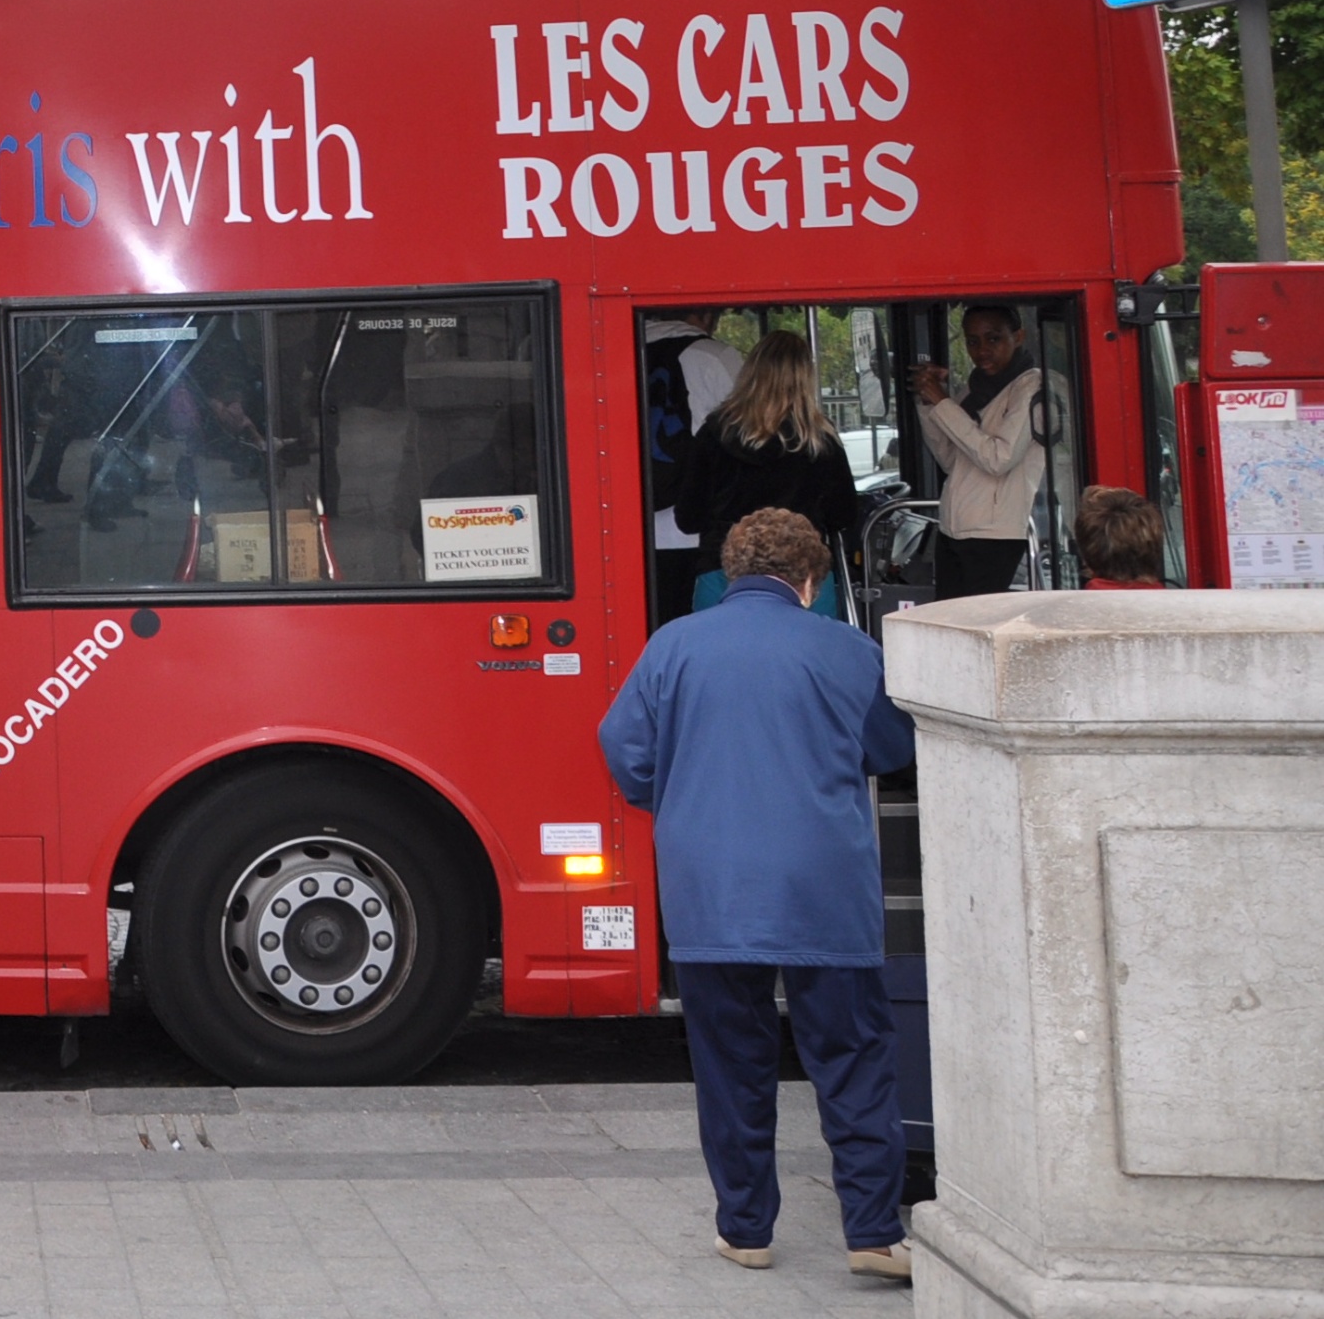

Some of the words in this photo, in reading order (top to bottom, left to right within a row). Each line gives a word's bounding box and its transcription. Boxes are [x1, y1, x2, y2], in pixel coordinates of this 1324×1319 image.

[489, 17, 651, 137] LES
[677, 6, 911, 129] CARS
[125, 56, 375, 227] with
[498, 140, 920, 240] ROUGES
[433, 549, 472, 560] TICKET
[474, 545, 530, 557] VOUCHERS
[434, 559, 500, 571] EXCHANGED
[501, 557, 529, 567] HERE
[476, 660, 543, 671] VOLVO
